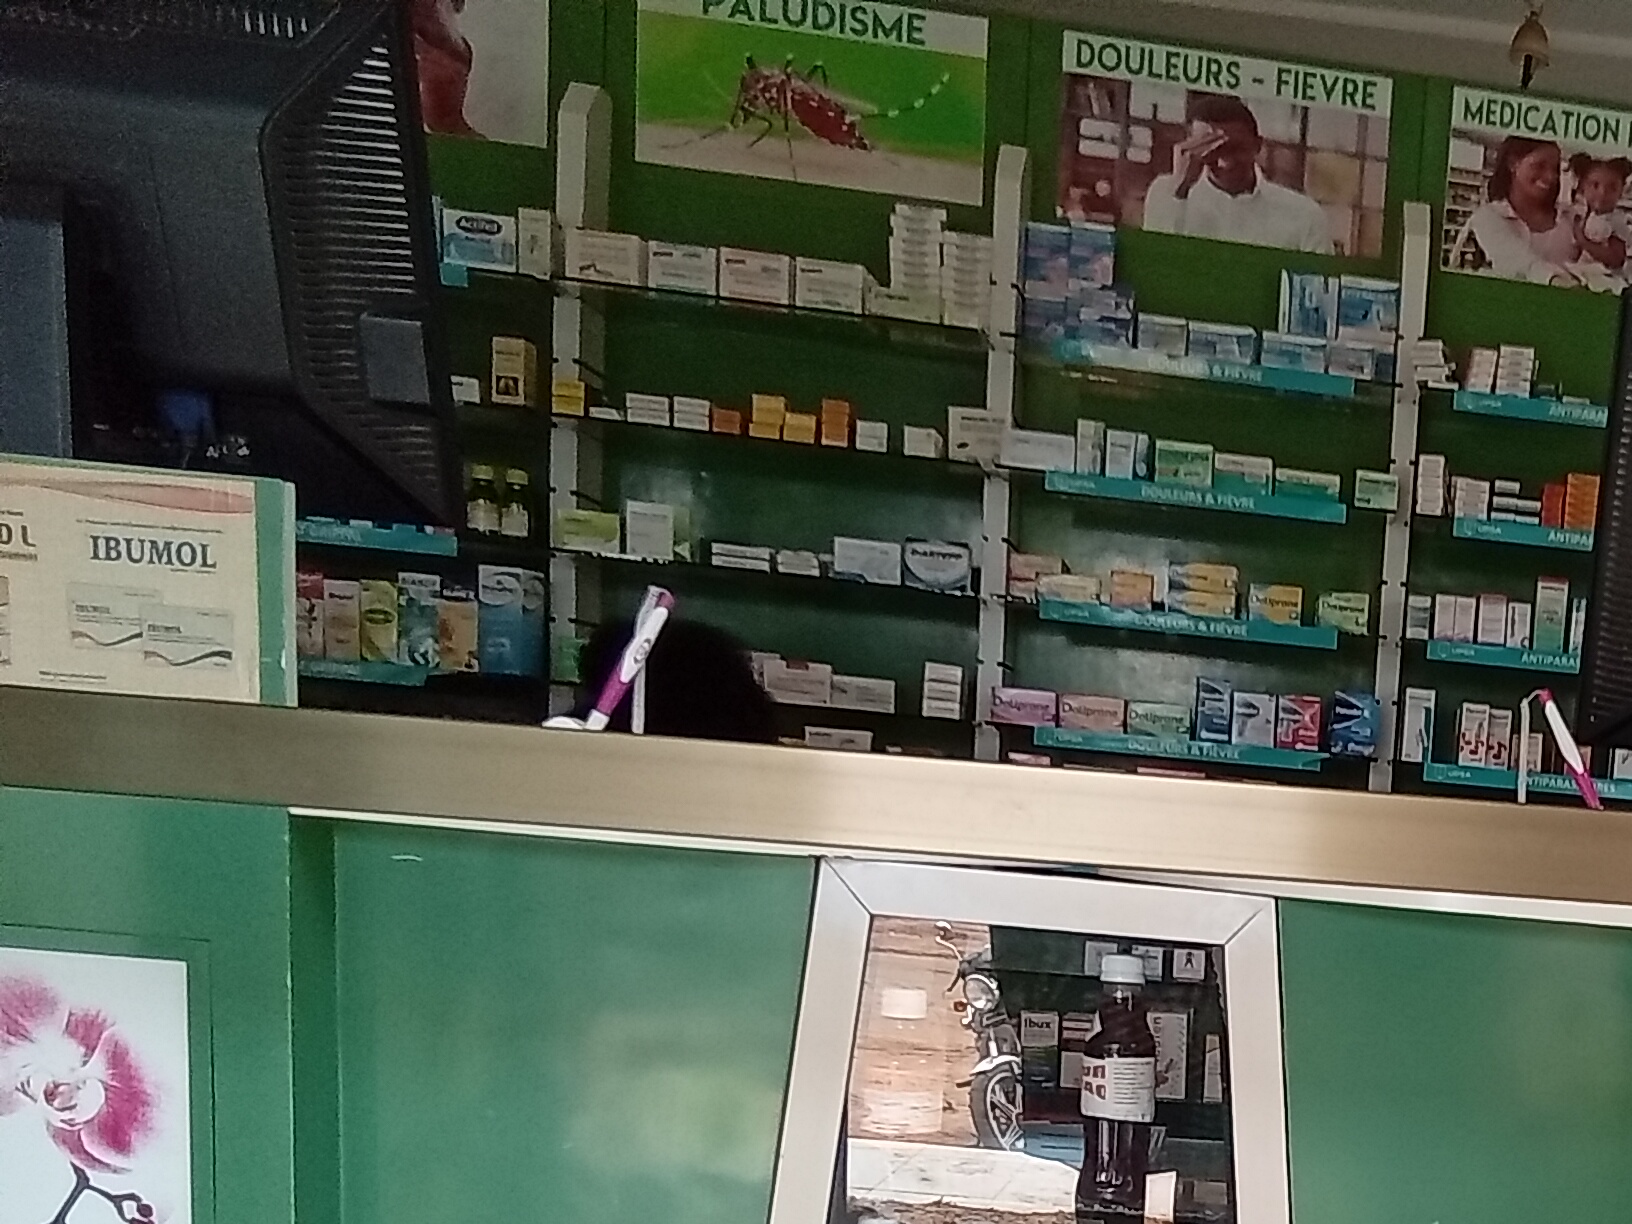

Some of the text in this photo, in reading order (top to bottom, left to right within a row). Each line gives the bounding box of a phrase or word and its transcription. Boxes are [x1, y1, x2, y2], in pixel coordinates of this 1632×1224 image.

[1076, 39, 1241, 90] DOULEURS
[1276, 67, 1379, 110] FIEVRE
[1463, 97, 1620, 144] MEDICATION
[89, 534, 217, 569] IBUMOL
